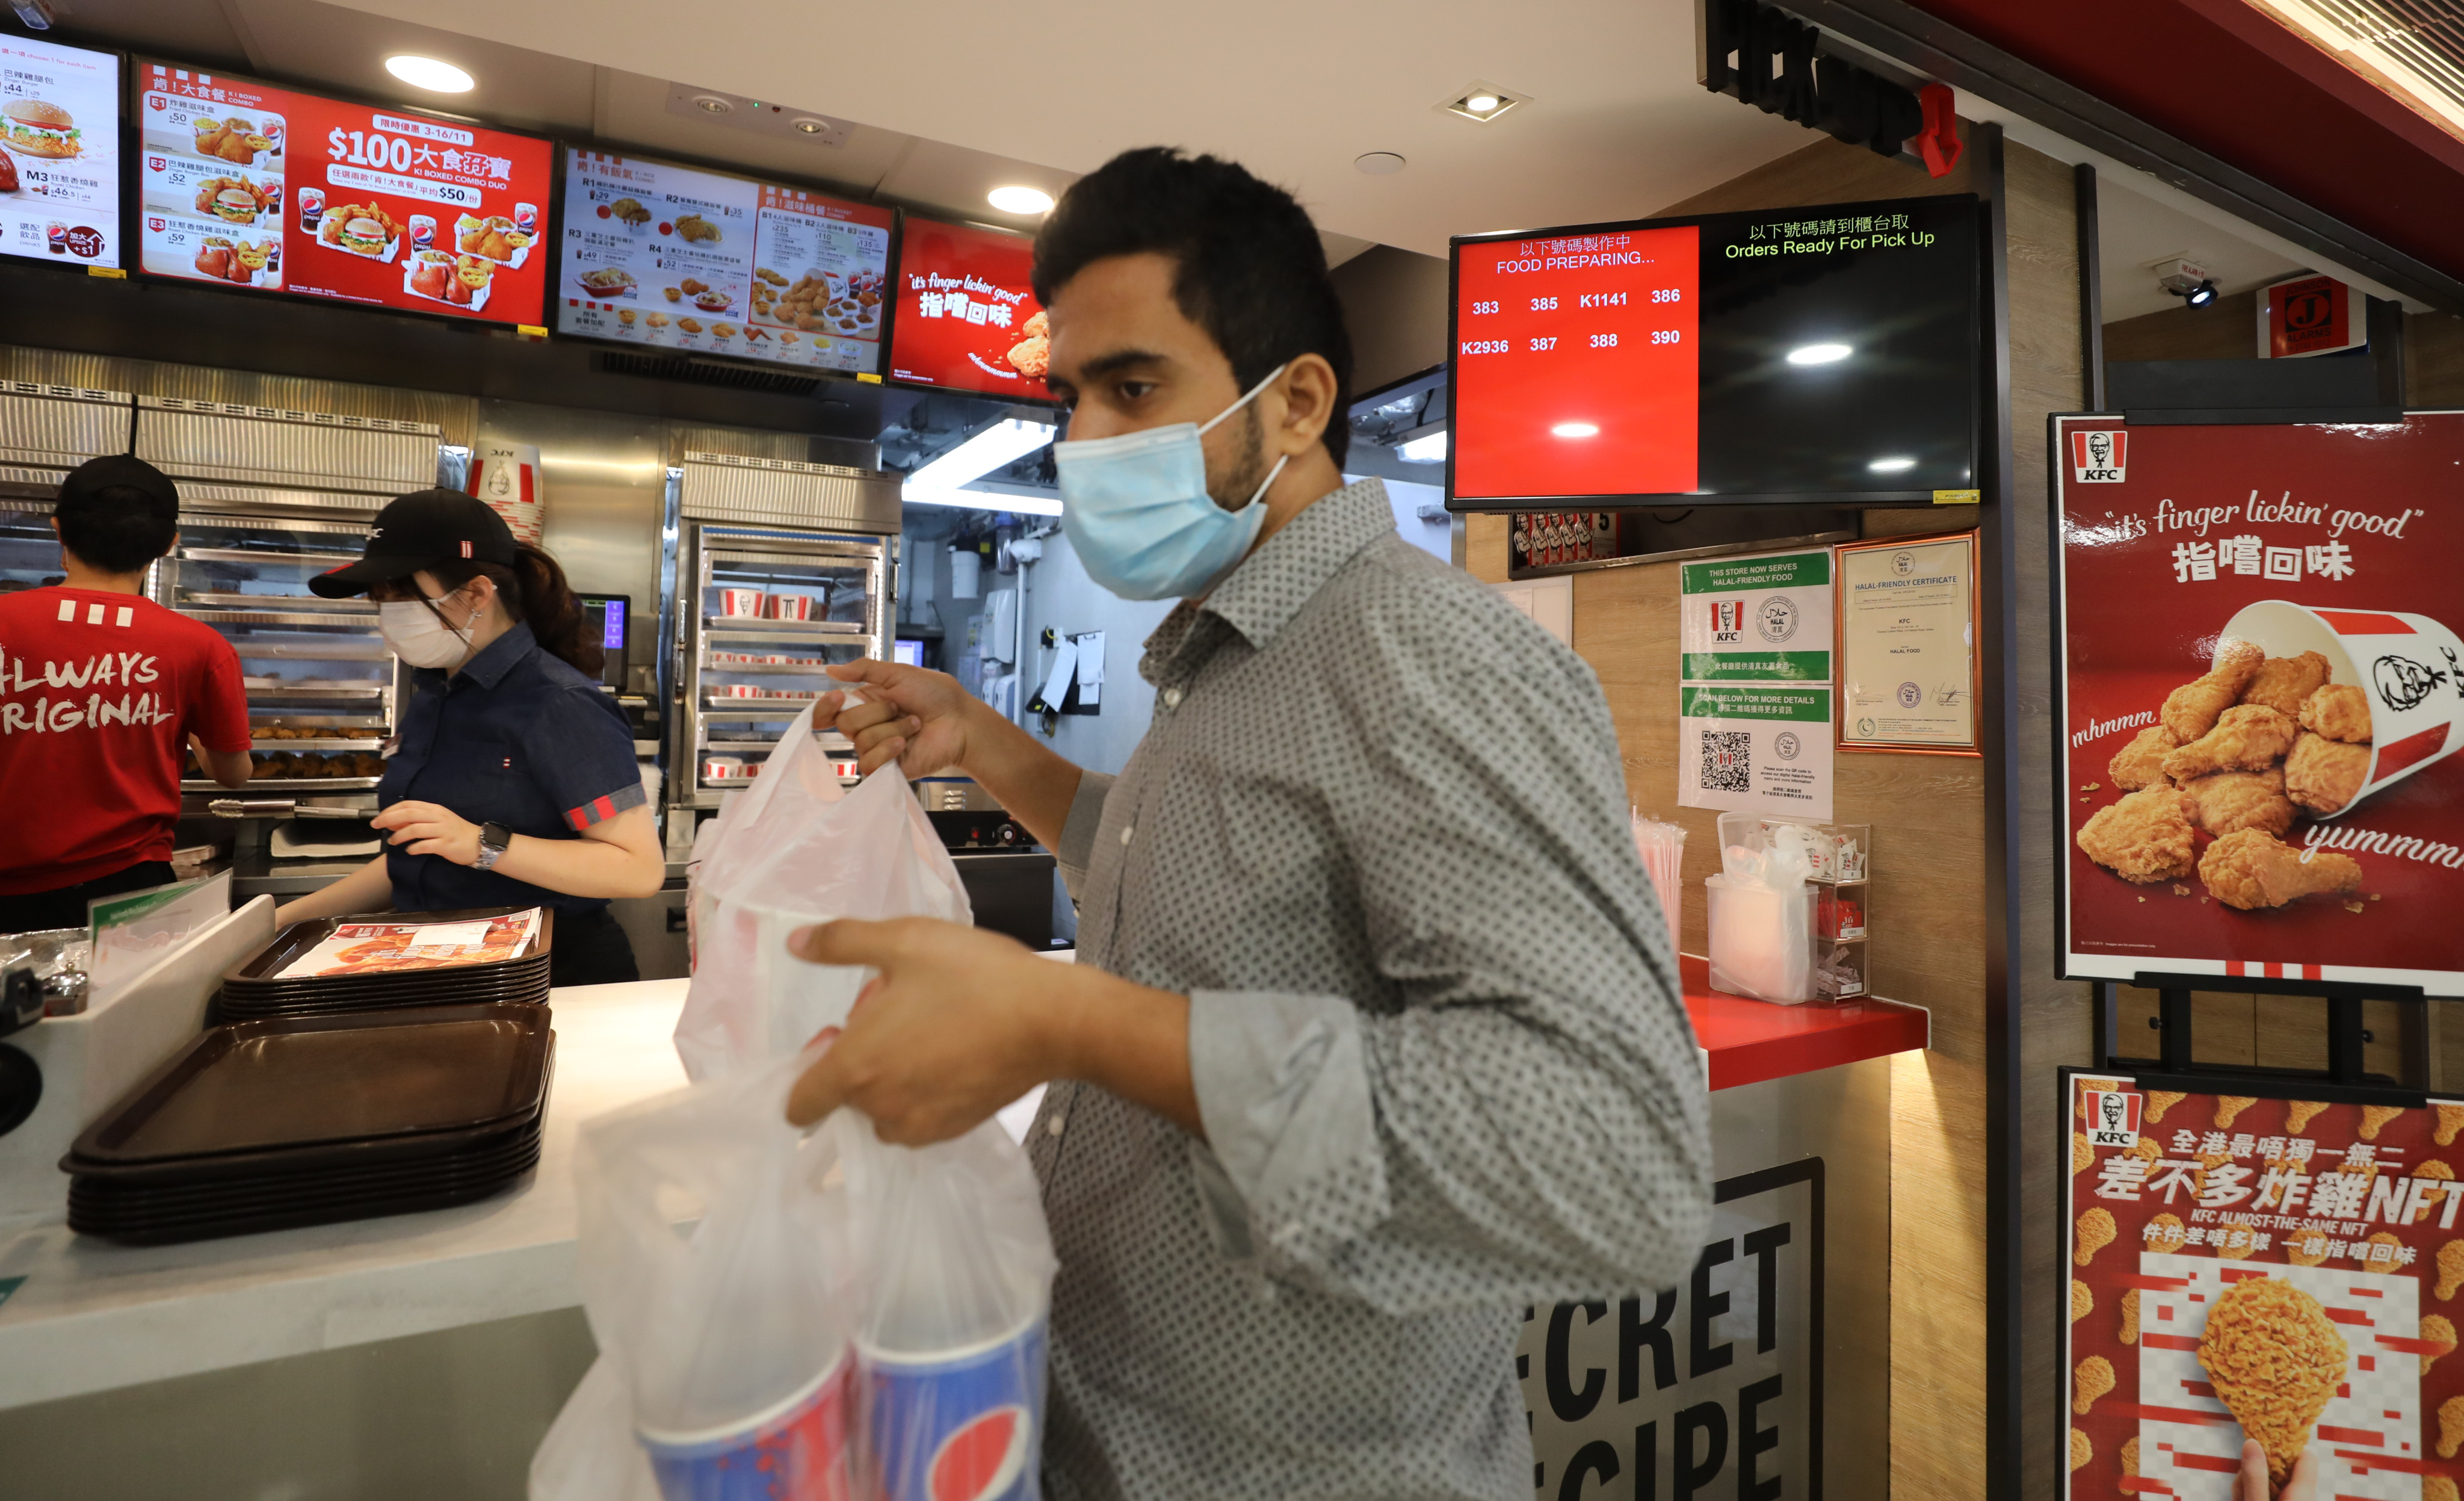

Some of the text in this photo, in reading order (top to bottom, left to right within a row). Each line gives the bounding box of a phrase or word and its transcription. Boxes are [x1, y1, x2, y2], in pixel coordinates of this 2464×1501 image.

[27, 53, 49, 61] choose
[4, 84, 22, 93] $44
[151, 97, 165, 108] E1
[228, 97, 254, 107] COMBO
[169, 113, 187, 122] $50
[424, 126, 466, 142] 3-16/11
[327, 126, 412, 173] $100
[150, 159, 165, 169] E2
[26, 170, 48, 182] M3
[168, 173, 186, 183] $52
[424, 169, 507, 190] BOXED COMBO DUO
[582, 178, 595, 188] R1
[666, 194, 679, 203] R2
[150, 220, 165, 229] E3
[1749, 214, 1909, 241] 以下號碼請到櫃台取
[19, 231, 40, 240] 飲品
[70, 232, 87, 241] 加大
[168, 234, 185, 242] $59
[569, 229, 581, 238] R3
[649, 244, 662, 253] R4
[1520, 234, 1631, 257] 以下號碼製作中
[1726, 231, 1935, 259] Orders Ready For Pick Up
[1497, 250, 1655, 274] FOOD PREPARING...
[2188, 267, 2198, 276] ALARM
[928, 272, 963, 292] finger
[964, 274, 996, 295] lickin'
[2285, 277, 2330, 296] JOHNSON
[1472, 288, 1681, 315] 383 385 K1141 386
[919, 291, 1013, 329] 指嚐回味
[2296, 297, 2319, 324] J
[1462, 330, 1681, 354] K2936 387 388 390
[2287, 327, 2332, 342] ALARMS
[490, 448, 514, 457] KFC
[2084, 469, 2117, 480] KFC
[2153, 499, 2240, 536] finger
[2172, 534, 2355, 583] 指嚐回味
[1768, 563, 1797, 572] SERVES
[1713, 573, 1793, 586] HALAL-FRIENDLY FOOD
[1855, 575, 1957, 591] HALAL-FRIENDLY CERTIFICATE
[1766, 608, 1788, 619] حلال
[1717, 633, 1738, 642] KFC
[0, 692, 175, 735] RIGINAL
[2072, 710, 2157, 748] mhmmm
[2299, 825, 2464, 869] yummm
[2096, 1131, 2131, 1144] KFC
[2169, 1128, 2405, 1169] 全港最唔獨一無二
[2095, 1154, 2464, 1230] 差不多炸雞NFT
[2191, 1209, 2368, 1236] KFC ALMOST-THE-SAME NFT
[2142, 1223, 2270, 1251] 件件差唔多樣
[1516, 1222, 1791, 1422] CRET
[1527, 1373, 1782, 1501] CIPE
